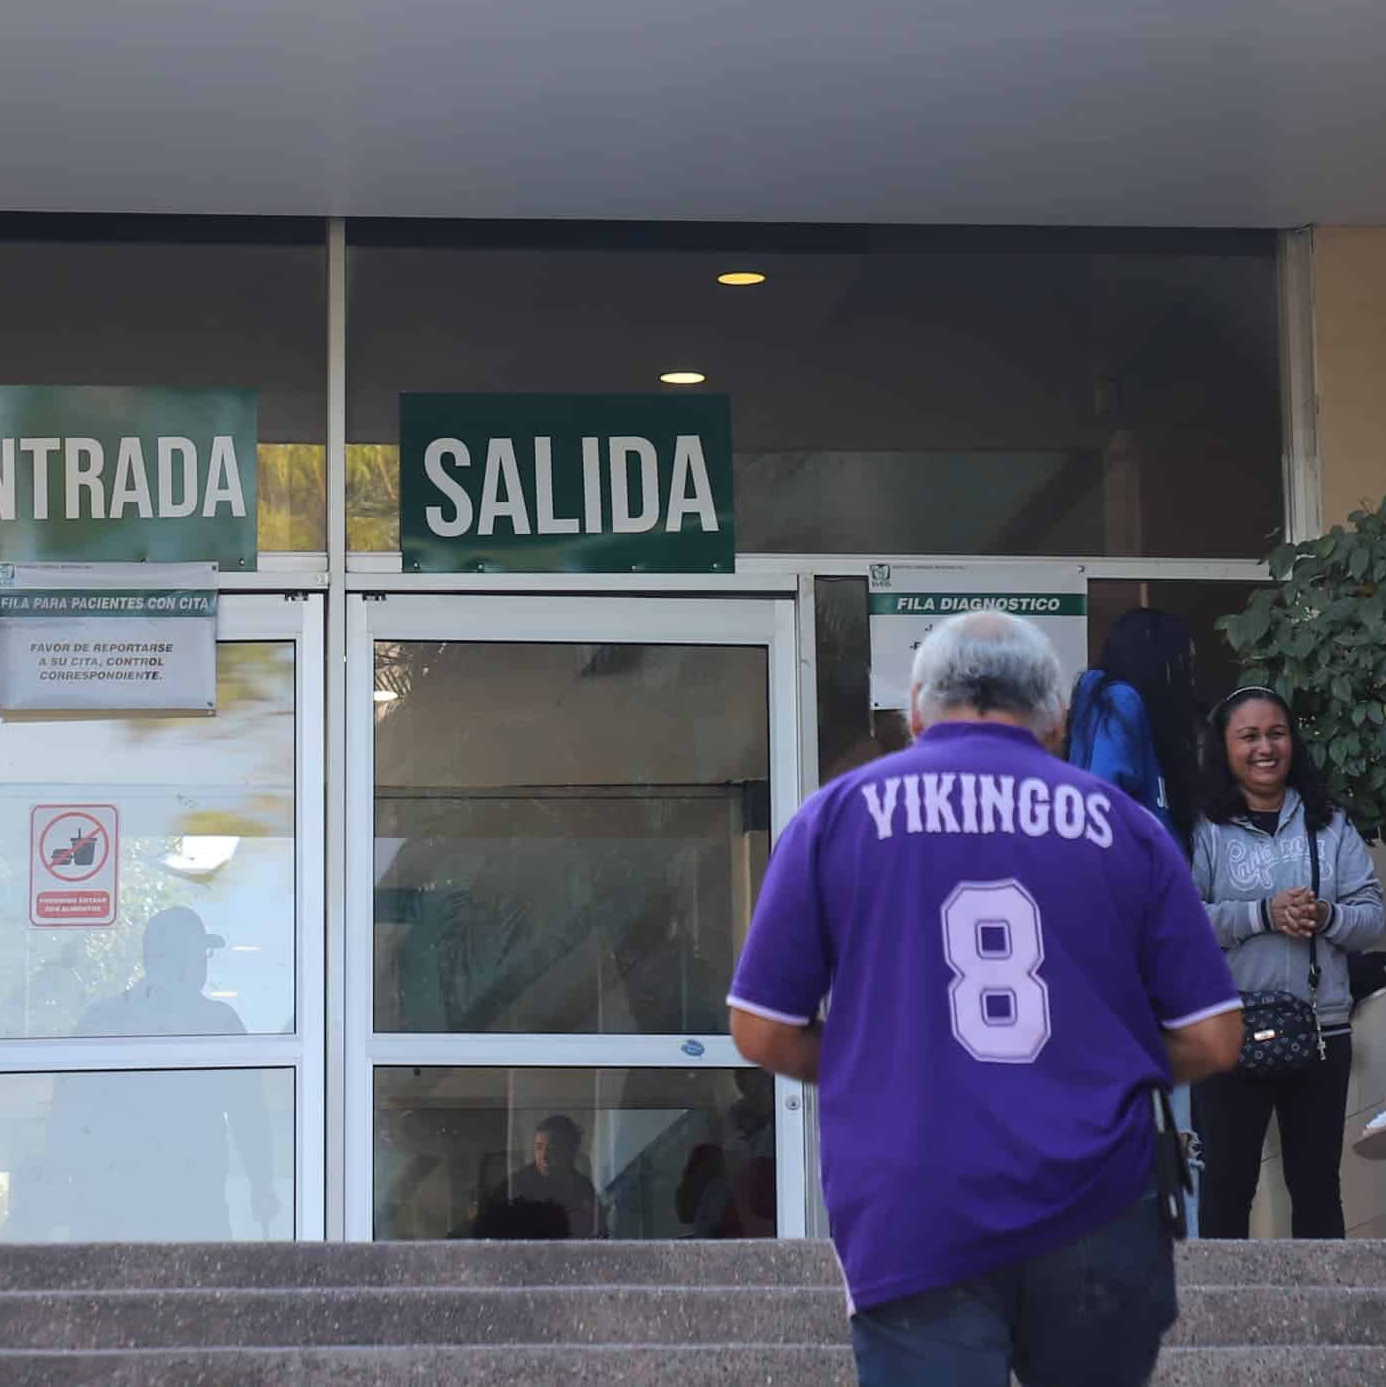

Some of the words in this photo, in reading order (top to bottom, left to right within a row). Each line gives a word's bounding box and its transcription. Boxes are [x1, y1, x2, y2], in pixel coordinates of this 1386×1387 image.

[424, 434, 720, 538] SALIDA
[0, 598, 31, 610] FILA
[32, 598, 69, 610] PARA
[70, 598, 145, 610] PACIENTES
[147, 598, 177, 610] CON
[179, 598, 210, 610] CITA
[897, 597, 935, 611] FILA
[939, 597, 1061, 612] DIAGNOSTICO
[29, 643, 70, 653] FAVOR
[73, 643, 89, 653] DE
[92, 643, 174, 653] REPORTARSE
[38, 657, 47, 667] A
[50, 657, 68, 667] SU
[70, 657, 102, 669] CITA,
[106, 657, 165, 667] CONTROL
[39, 671, 163, 681] CORRESPONDIENTE.
[861, 772, 1114, 849] VIKINGOS
[938, 876, 1052, 1065] 8
